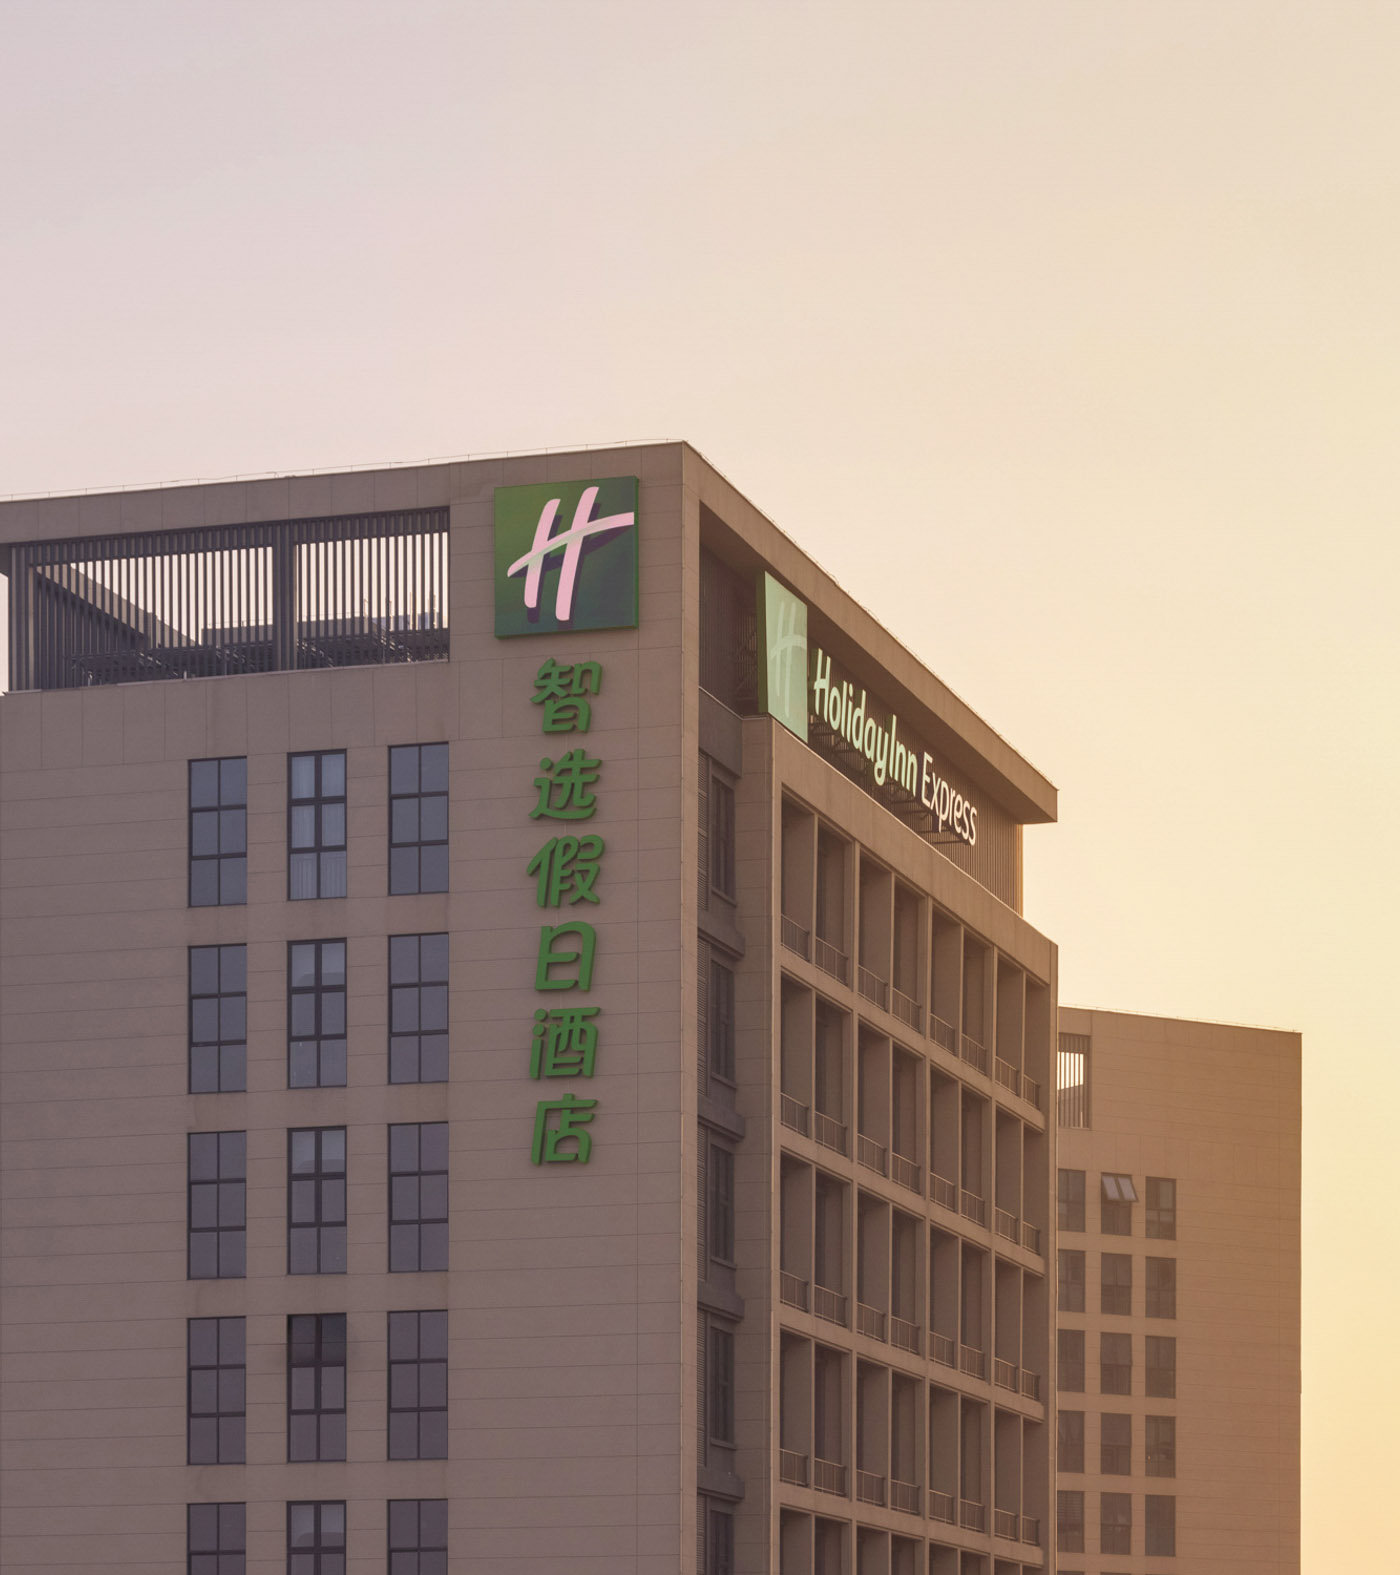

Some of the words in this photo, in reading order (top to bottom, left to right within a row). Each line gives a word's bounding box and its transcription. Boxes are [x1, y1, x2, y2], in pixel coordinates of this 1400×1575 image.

[526, 657, 603, 1165] 智选假日酒店
[921, 751, 978, 846] Express
